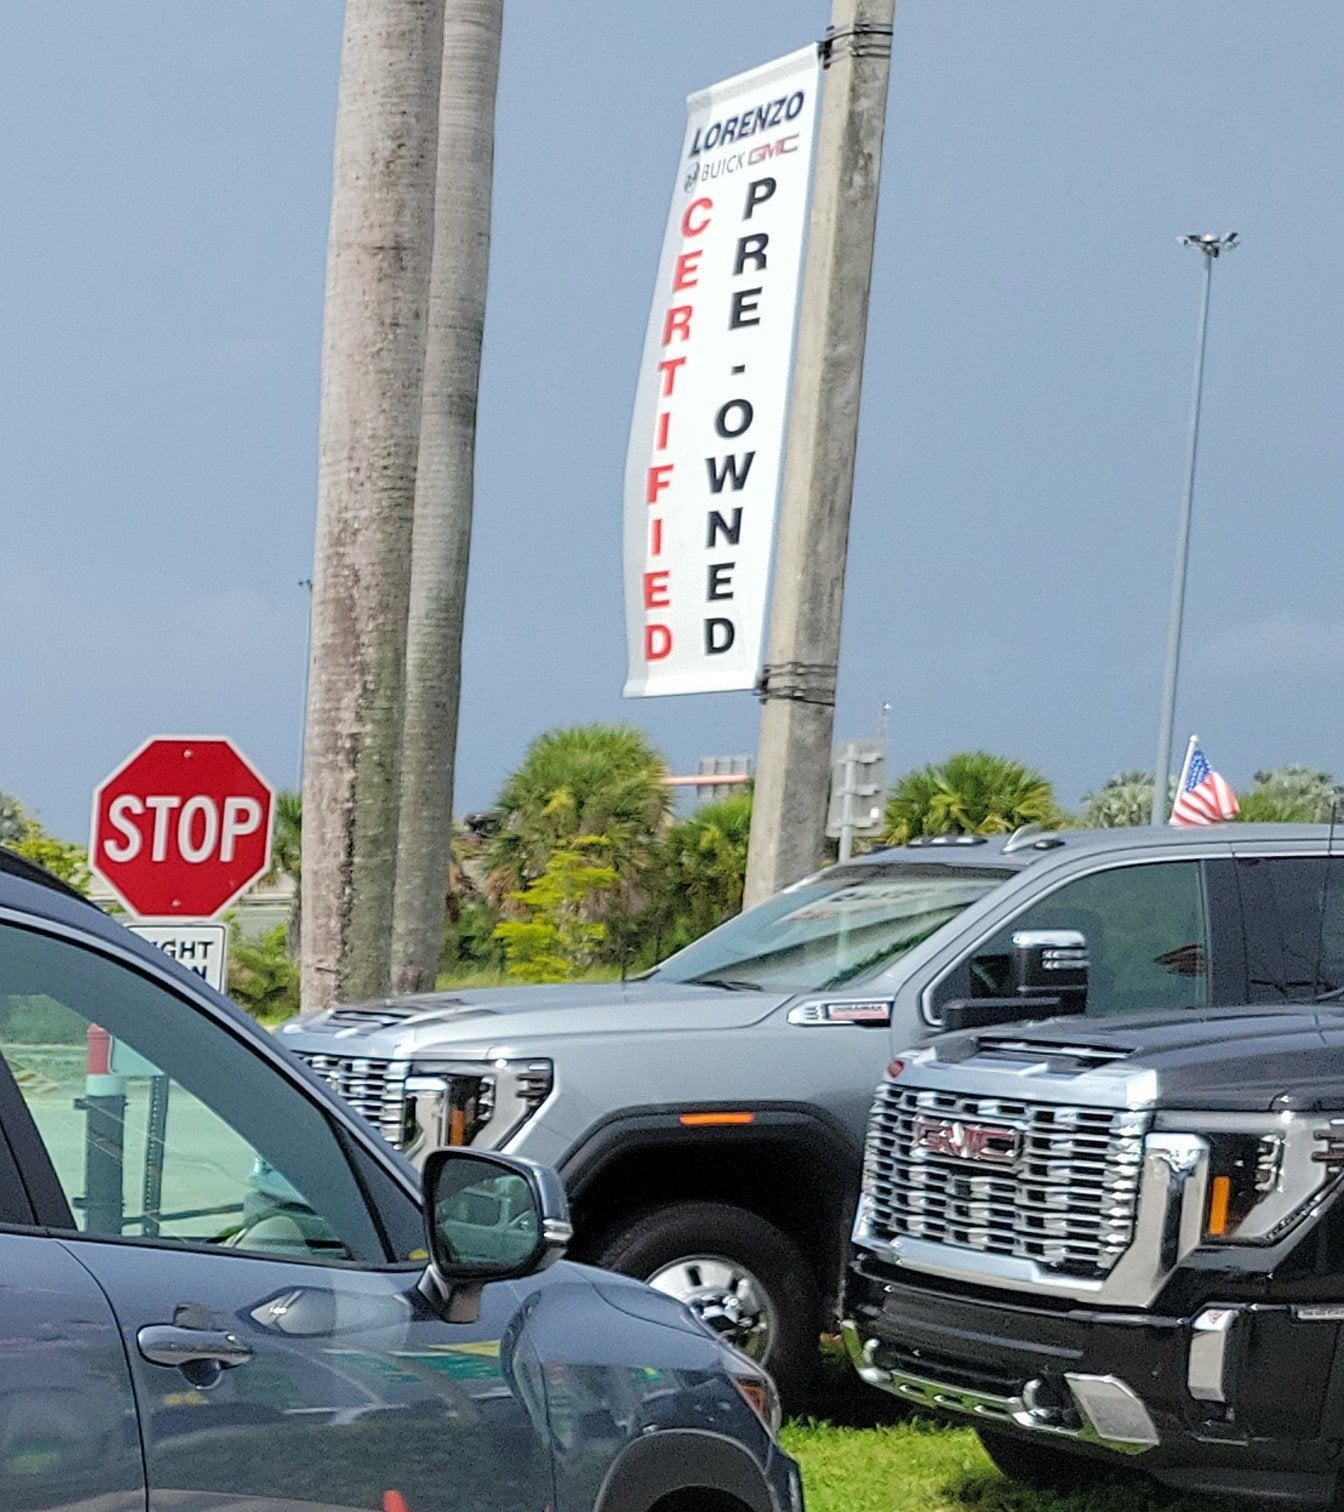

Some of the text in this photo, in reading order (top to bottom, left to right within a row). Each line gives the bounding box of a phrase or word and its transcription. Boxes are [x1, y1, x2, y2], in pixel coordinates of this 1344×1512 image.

[688, 90, 805, 158] LORENZO
[701, 133, 800, 182] BUICK GMC
[643, 197, 713, 662] CERTIFIED
[103, 794, 262, 863] STOP
[151, 941, 214, 960] GHT
